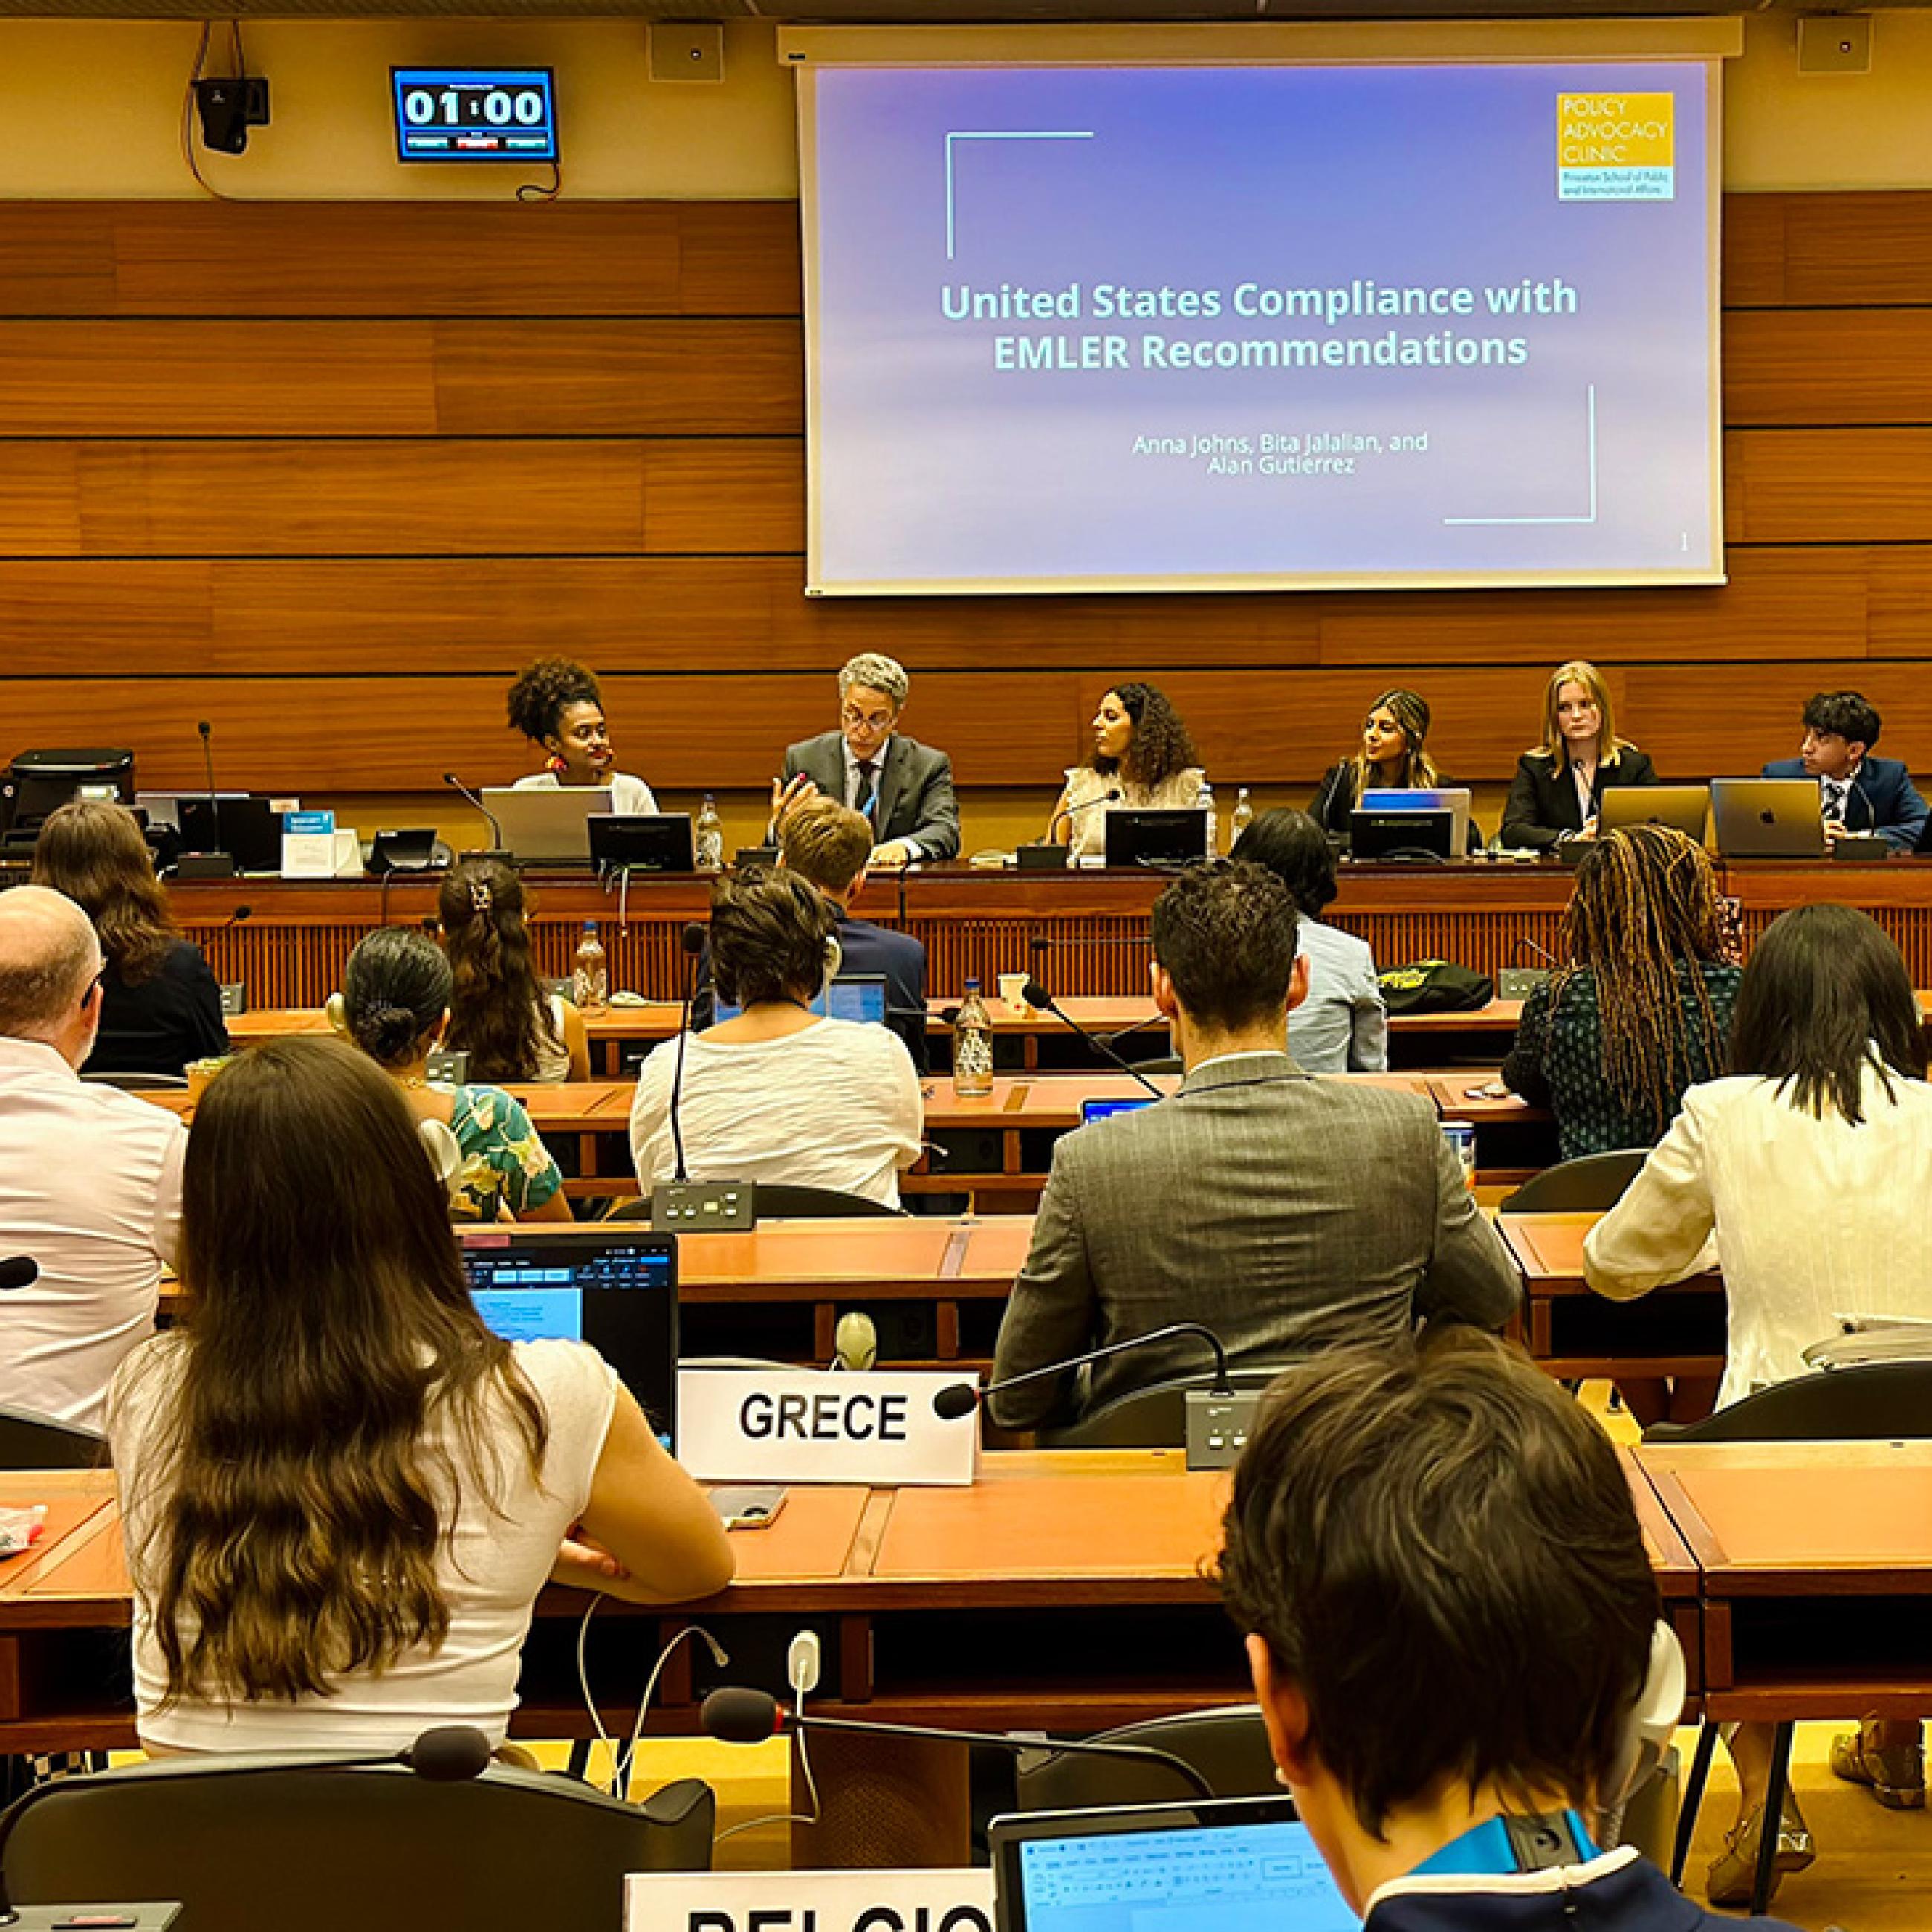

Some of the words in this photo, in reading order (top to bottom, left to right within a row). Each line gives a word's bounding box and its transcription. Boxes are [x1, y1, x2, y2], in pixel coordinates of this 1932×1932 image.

[406, 90, 543, 125] 01:00
[1563, 99, 1627, 117] POLICY
[1563, 121, 1668, 140] ADVOCACY
[1563, 145, 1627, 163] CLINIC
[940, 283, 1081, 320] United
[1092, 284, 1222, 318] States
[1232, 280, 1475, 326] Compliance
[1484, 277, 1577, 315] with
[994, 334, 1130, 369] EMLER
[1142, 329, 1529, 369] Recommendations
[1132, 435, 1187, 453] Anna
[1190, 433, 1254, 457] Johns,
[1260, 432, 1300, 453] Bita
[1389, 432, 1427, 451] and
[1207, 455, 1253, 475] Alan
[739, 1393, 908, 1440] GRECE
